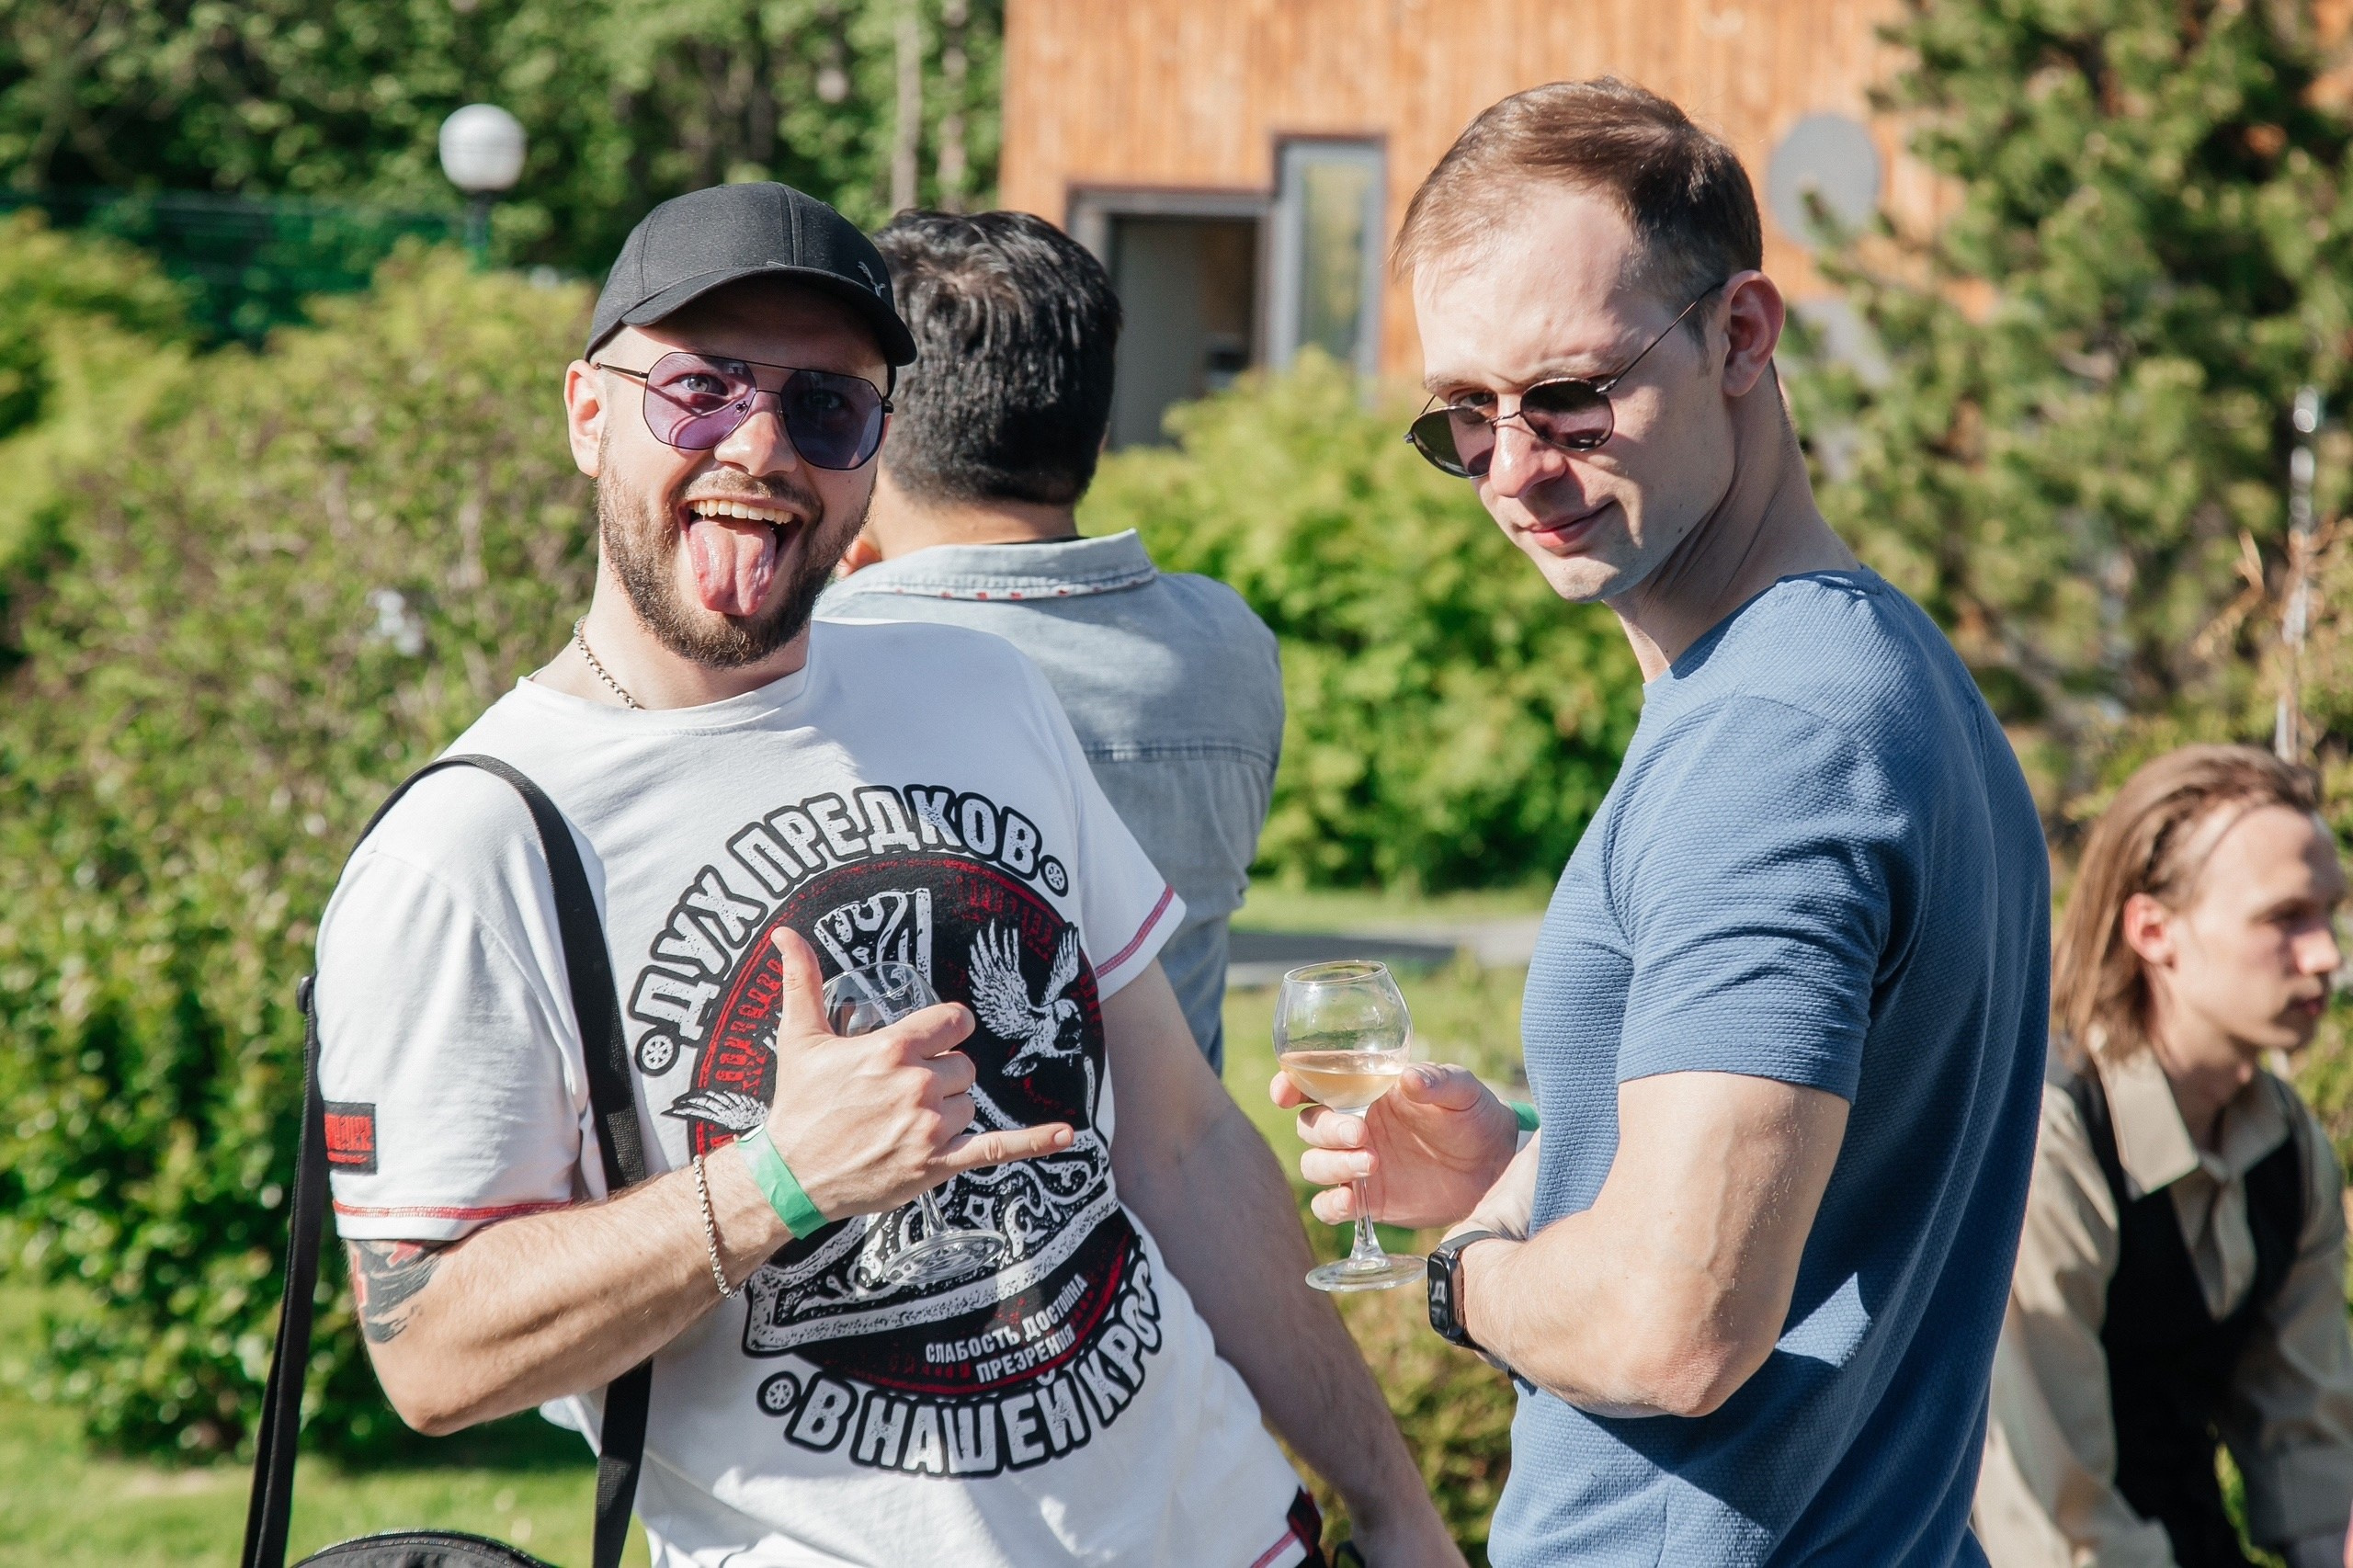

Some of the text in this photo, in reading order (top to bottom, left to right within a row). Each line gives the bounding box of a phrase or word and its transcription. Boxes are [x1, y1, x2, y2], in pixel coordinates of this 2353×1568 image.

[630, 866, 767, 1045] ДУХ
[727, 786, 1041, 898] ПРЕДКОВ
[788, 1248, 1161, 1476] В НАШЕЙ КРОВ
[925, 1272, 1089, 1364] СЛАБОСТЬ ДОСТОЙНА
[975, 1323, 1077, 1383] ПРЕЗРЕНИЯ
